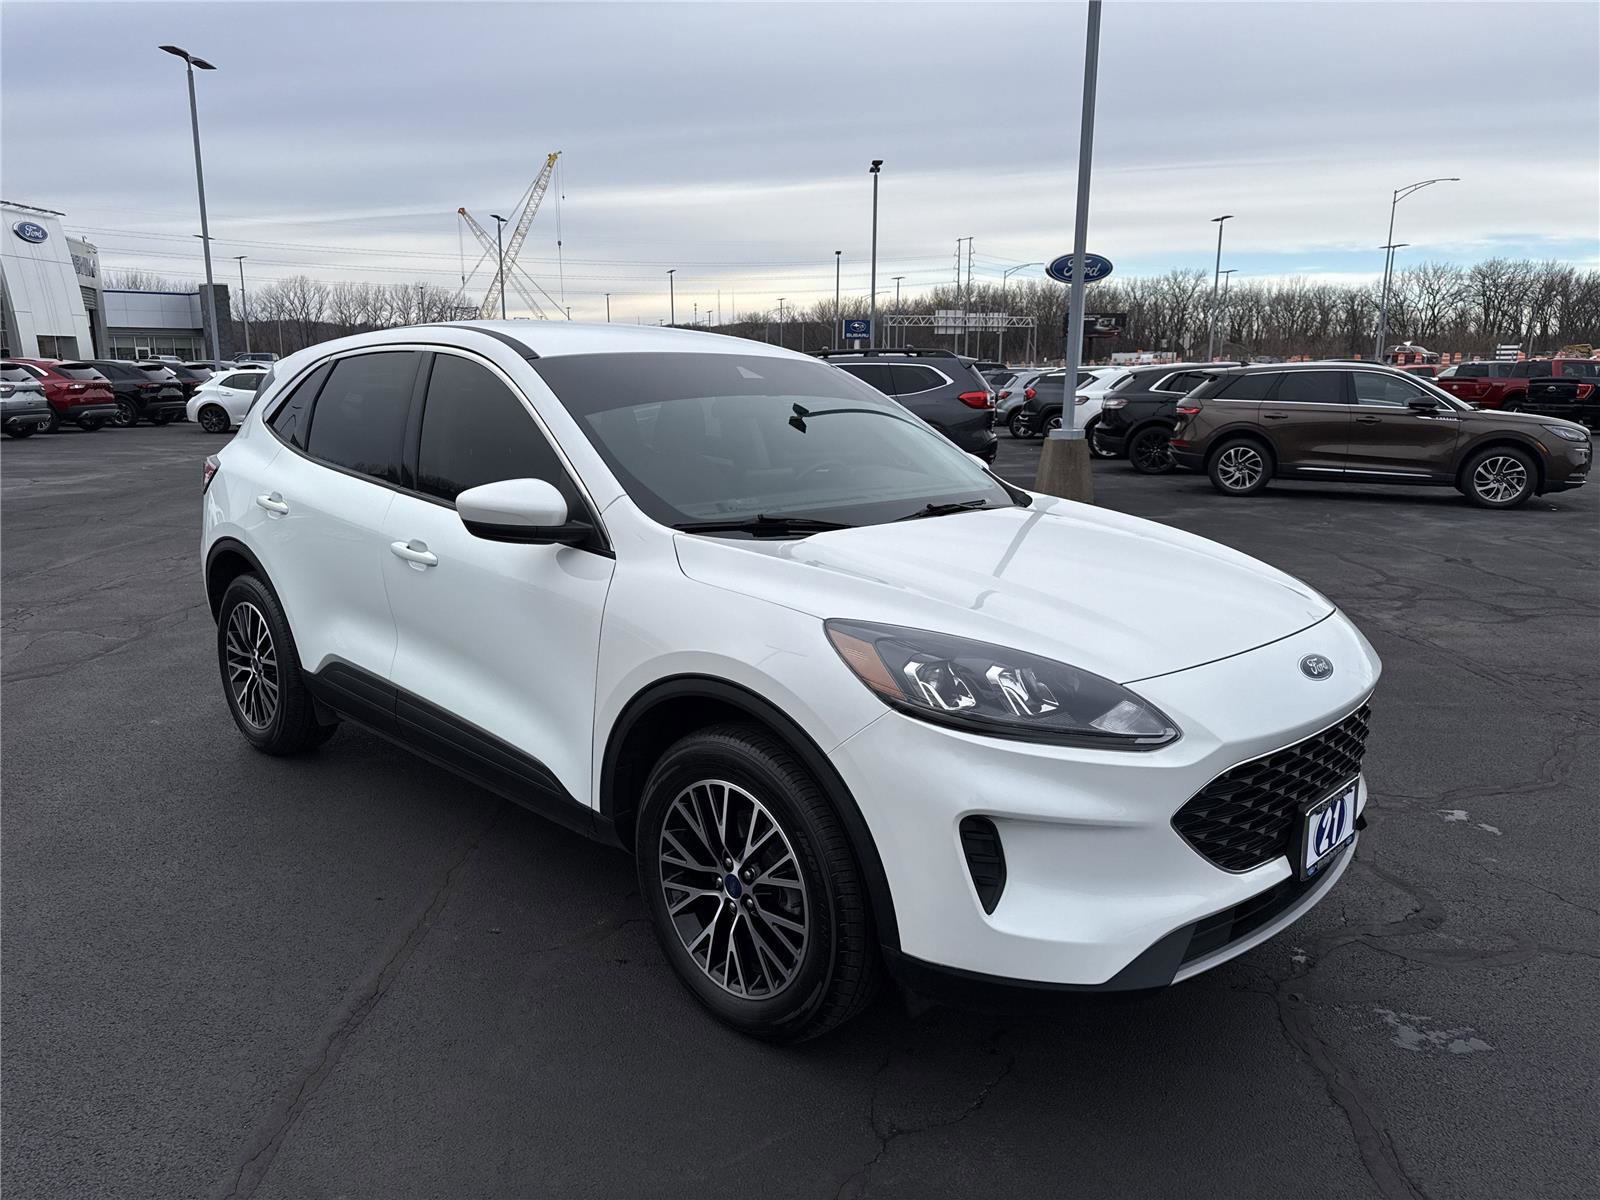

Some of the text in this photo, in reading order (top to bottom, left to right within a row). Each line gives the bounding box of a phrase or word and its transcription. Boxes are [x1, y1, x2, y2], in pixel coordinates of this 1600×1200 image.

[24, 224, 44, 239] Ford
[1063, 259, 1101, 276] Frd
[1306, 657, 1328, 675] Ford
[1319, 800, 1342, 854] 21
